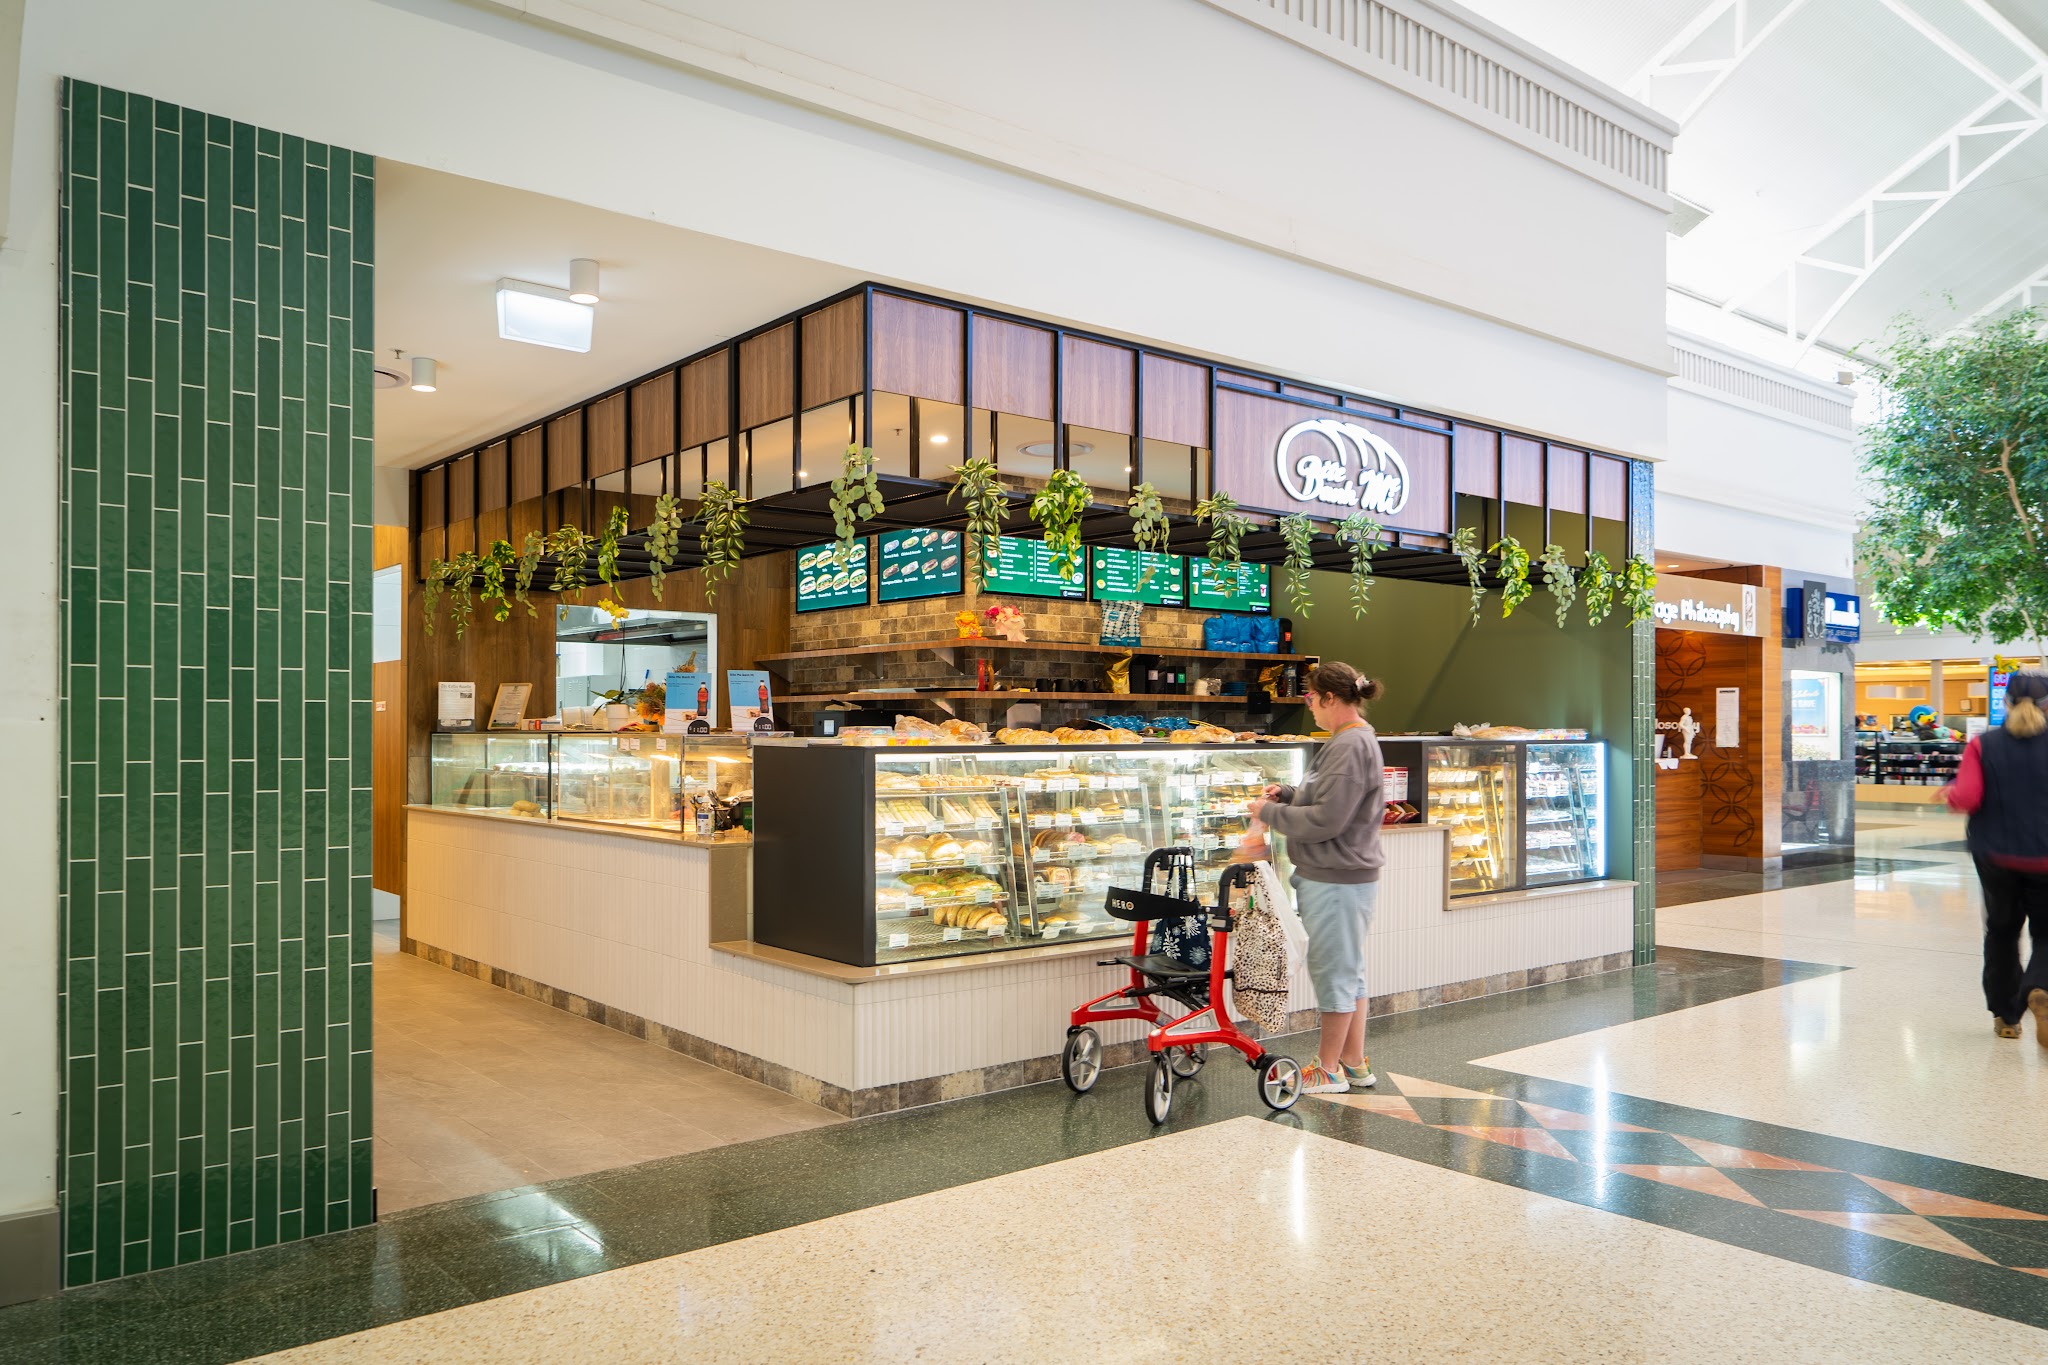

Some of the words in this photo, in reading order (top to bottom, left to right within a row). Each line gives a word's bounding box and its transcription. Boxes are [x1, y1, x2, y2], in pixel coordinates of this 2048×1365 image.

[1655, 602, 1679, 624] age
[1680, 599, 1740, 632] Philosophy
[1111, 899, 1135, 911] HERO
